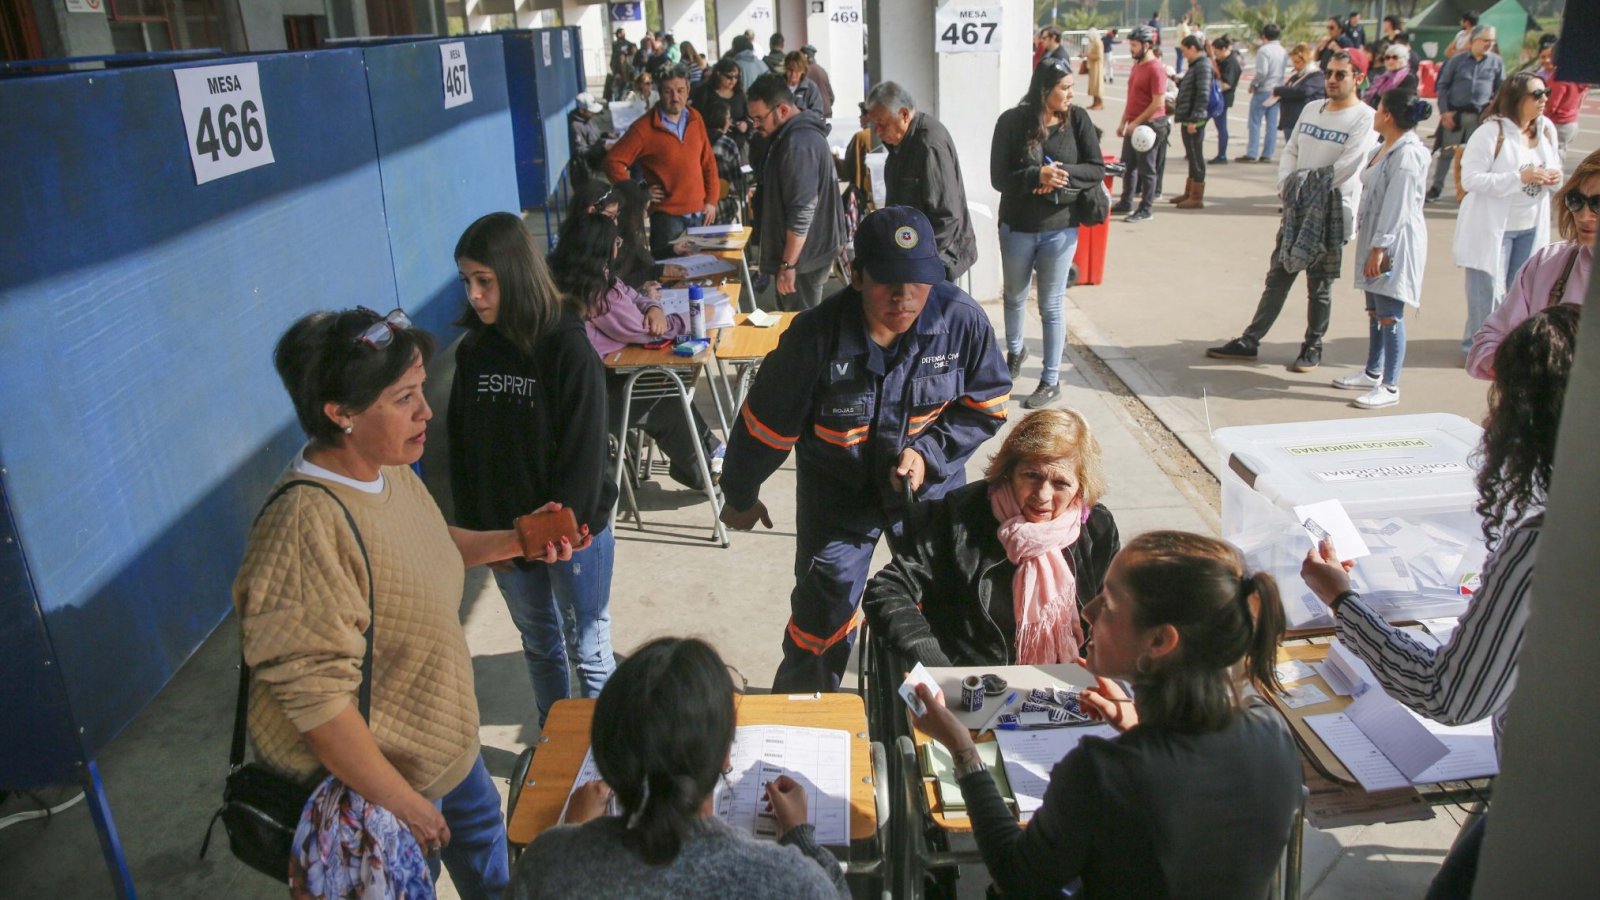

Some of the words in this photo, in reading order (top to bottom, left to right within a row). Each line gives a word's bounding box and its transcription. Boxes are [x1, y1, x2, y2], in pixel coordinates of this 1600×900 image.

[830, 11, 858, 23] 469
[959, 10, 987, 18] MESA
[941, 22, 998, 45] 467
[207, 75, 242, 95] MESA
[446, 64, 467, 97] 467
[196, 100, 264, 162] 466
[1300, 124, 1347, 143] BURTON
[921, 355, 946, 364] DEFENSA
[933, 360, 950, 368] CHILE
[835, 362, 849, 376] V
[477, 374, 536, 397] ESPRIT
[1362, 440, 1425, 449] PUEBLOS
[1320, 463, 1458, 477] CONSTITUCIONAL
[1355, 469, 1433, 479] CONSEJO
